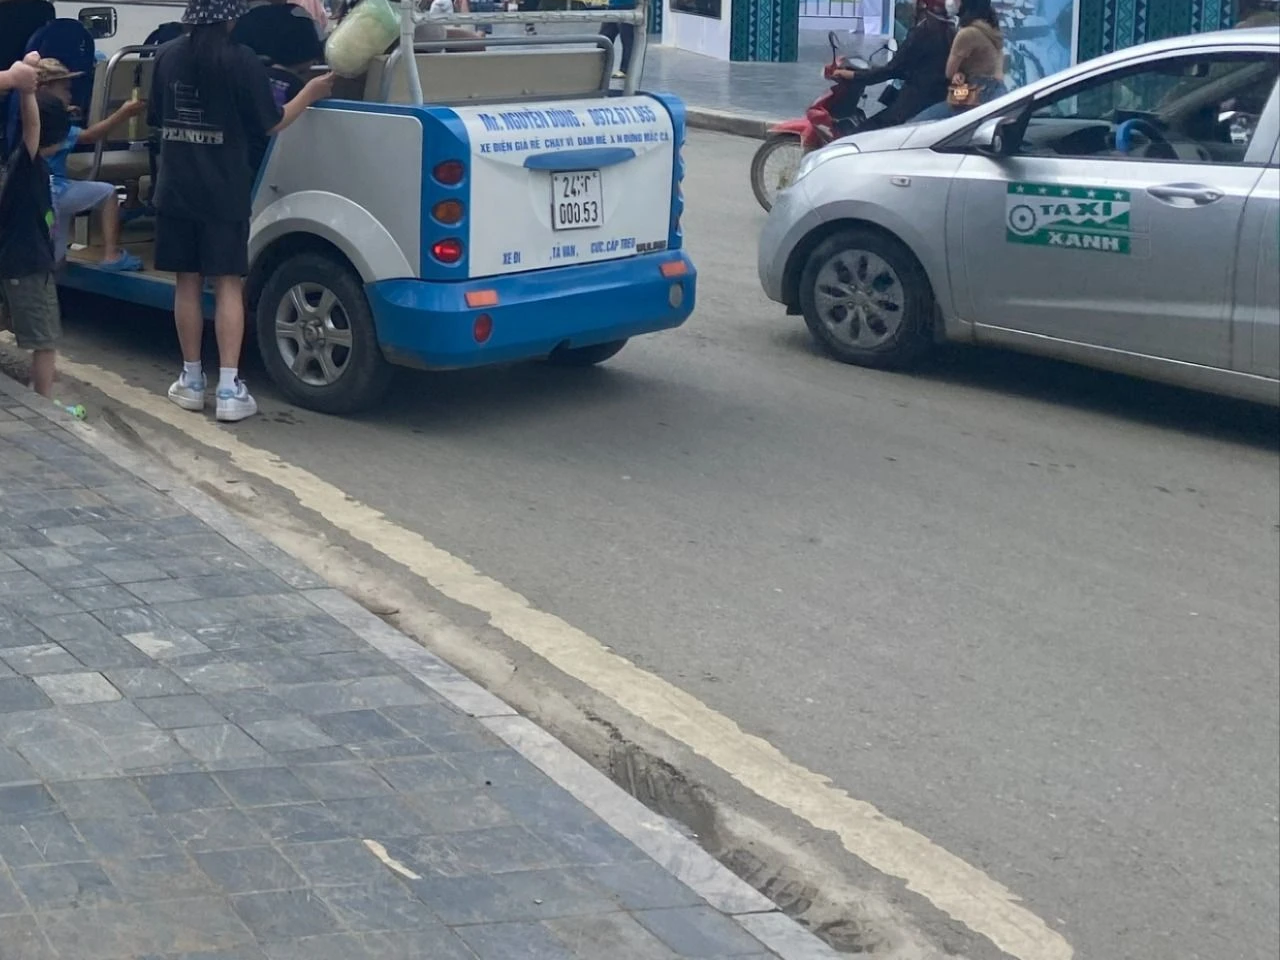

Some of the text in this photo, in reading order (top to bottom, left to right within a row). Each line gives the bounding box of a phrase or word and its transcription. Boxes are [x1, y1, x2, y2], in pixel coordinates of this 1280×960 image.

[478, 113, 504, 131] Mr.
[480, 143, 491, 153] XE
[1039, 202, 1113, 216] TAXI
[1047, 230, 1120, 251] XANH
